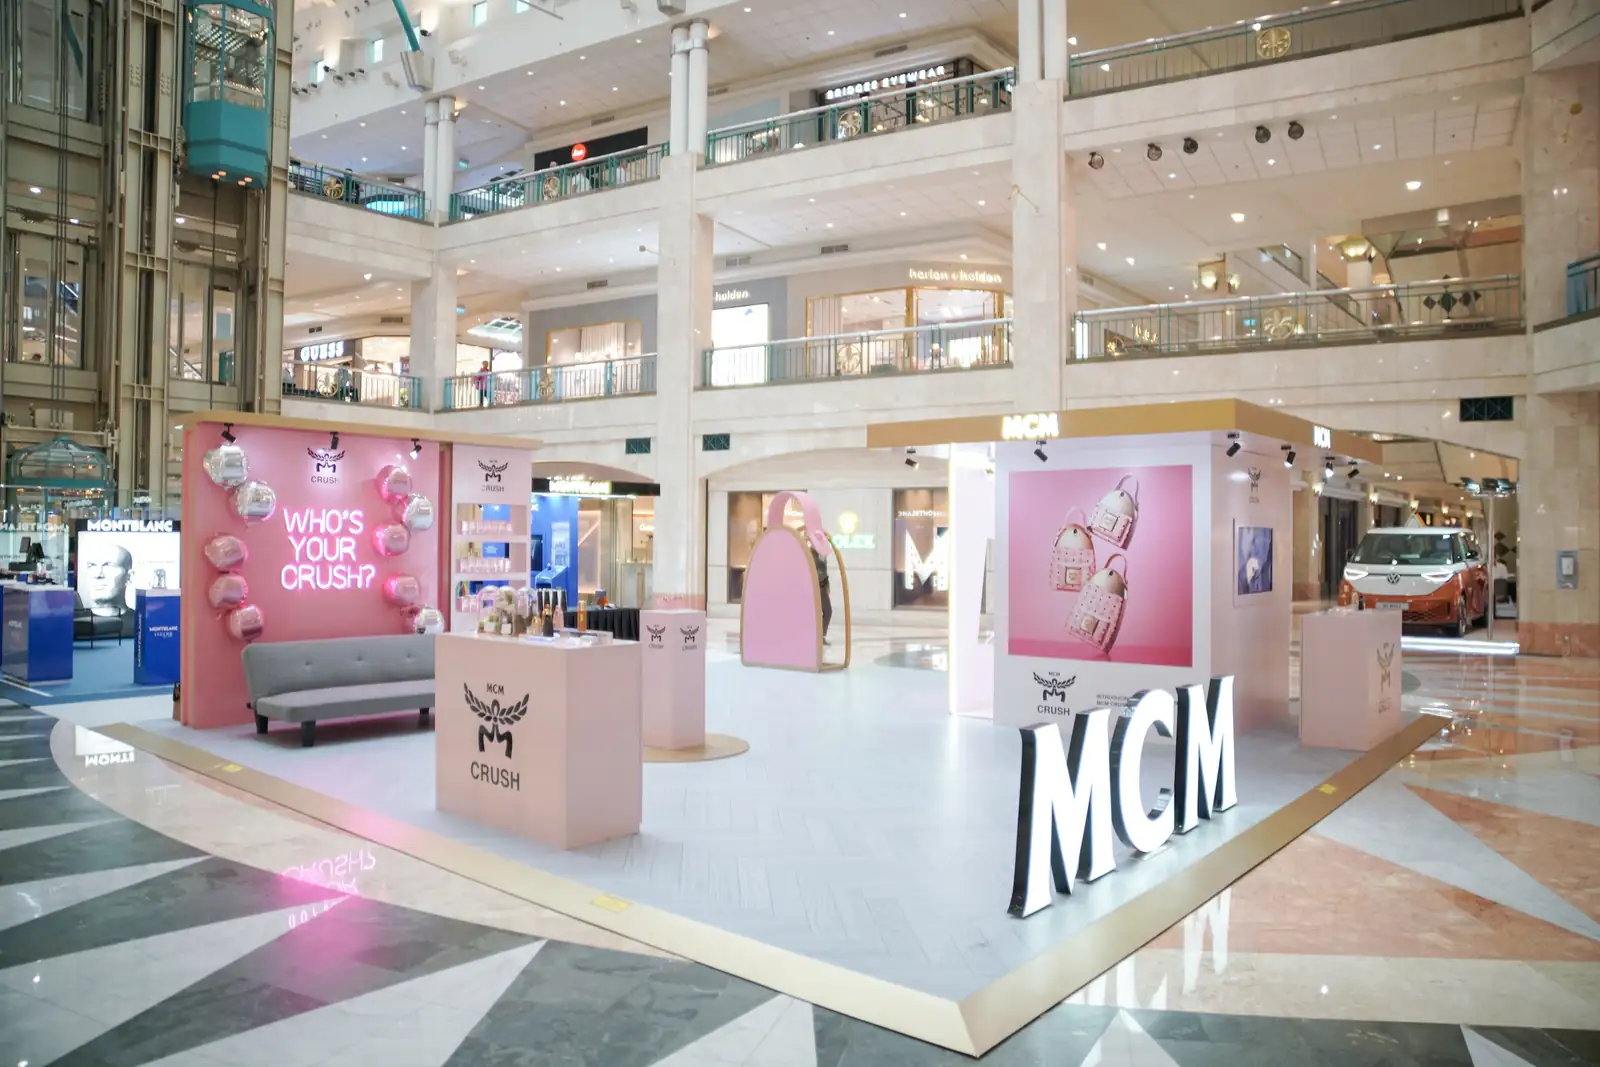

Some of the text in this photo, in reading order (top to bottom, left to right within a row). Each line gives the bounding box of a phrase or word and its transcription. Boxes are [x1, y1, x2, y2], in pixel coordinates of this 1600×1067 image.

[881, 65, 945, 88] EYEWEAR
[300, 340, 345, 362] GUESS
[1001, 411, 1060, 441] MCM
[310, 475, 340, 485] CRUSH
[86, 519, 174, 533] MONTBLANC
[283, 507, 365, 535] WHO'S
[287, 535, 357, 562] YOUR
[831, 533, 876, 549] OLEX
[280, 563, 377, 590] CRUSH?
[486, 682, 505, 695] MCM
[1037, 704, 1071, 716] CRUSH
[470, 760, 520, 791] CRUSH
[1007, 674, 1238, 920] MCM
